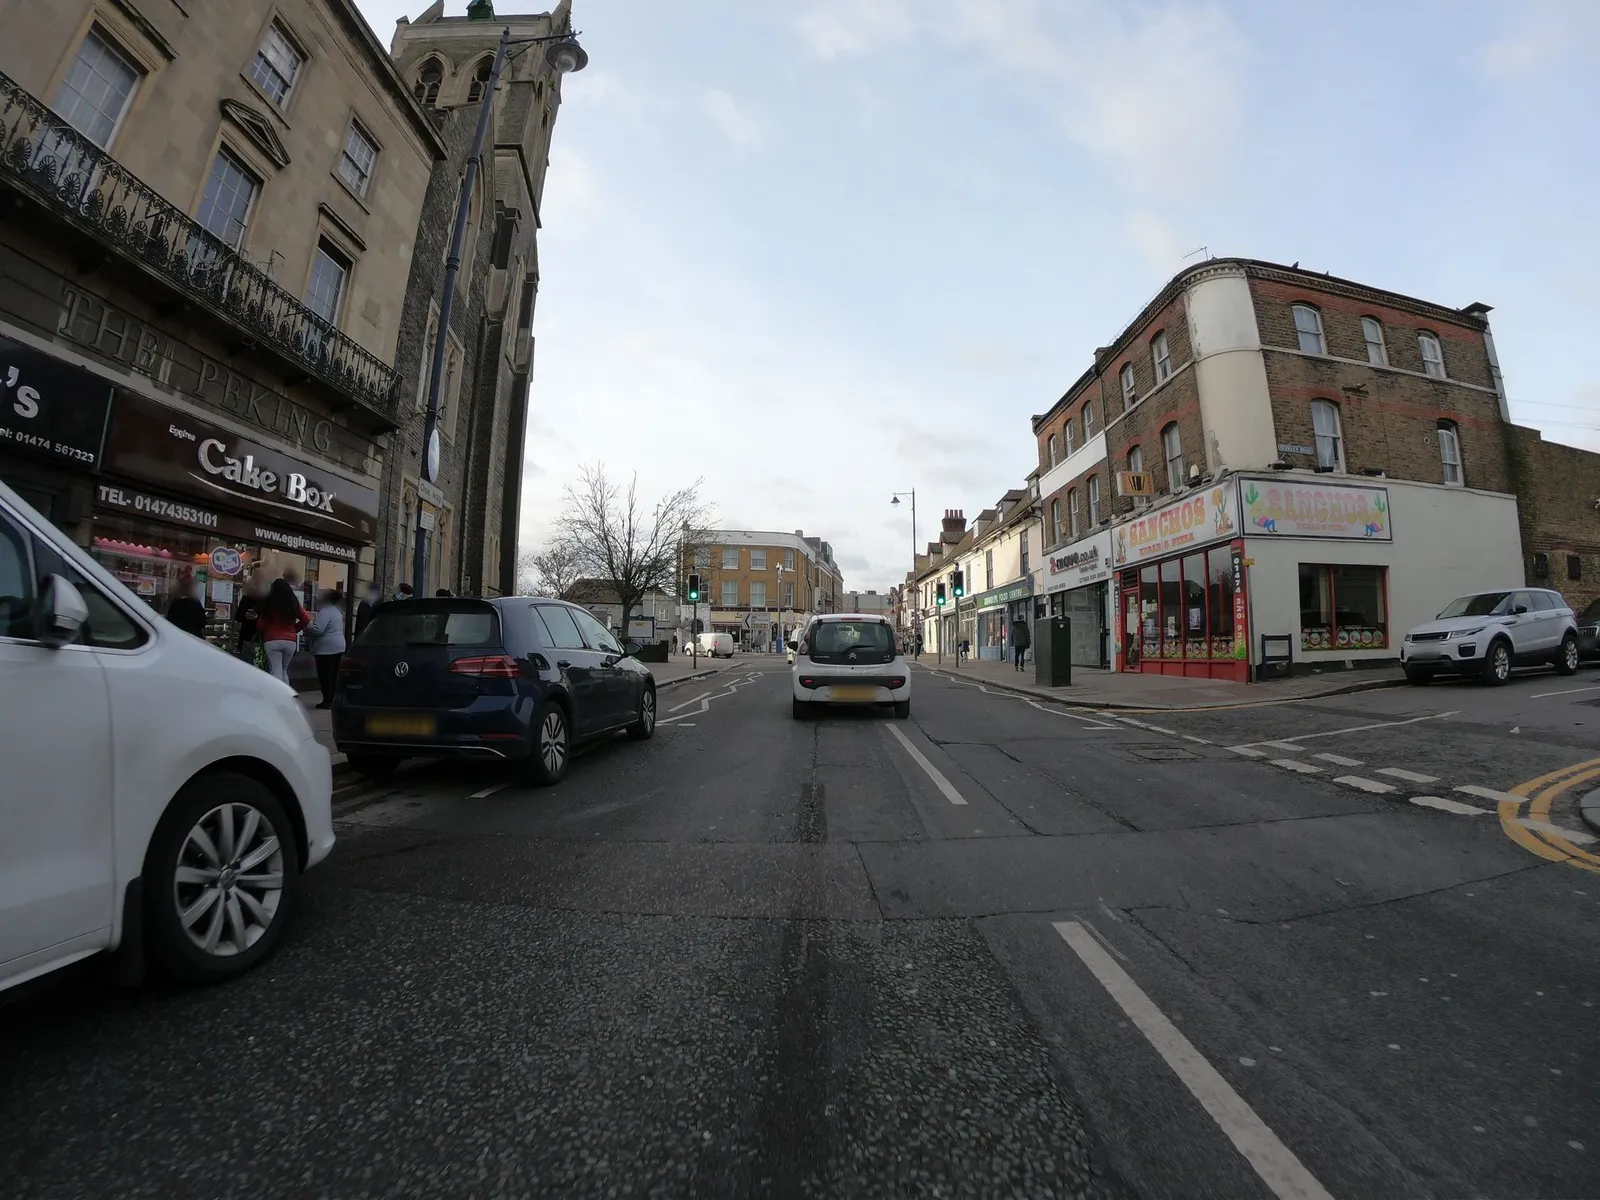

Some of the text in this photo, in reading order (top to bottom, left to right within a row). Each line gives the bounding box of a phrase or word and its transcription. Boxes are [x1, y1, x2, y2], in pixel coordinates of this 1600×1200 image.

[0, 366, 41, 419] 's
[192, 356, 333, 453] PEKING
[0, 427, 95, 463] el: 01474 567323
[198, 438, 334, 513] Cake Box
[420, 482, 431, 497] One
[134, 495, 218, 528] 01474353101
[1129, 496, 1206, 548] SANCHOS
[1267, 488, 1370, 524] SANCHOS
[255, 526, 357, 560] www.eggfreecake.co.uk
[1233, 557, 1242, 594] 01474
